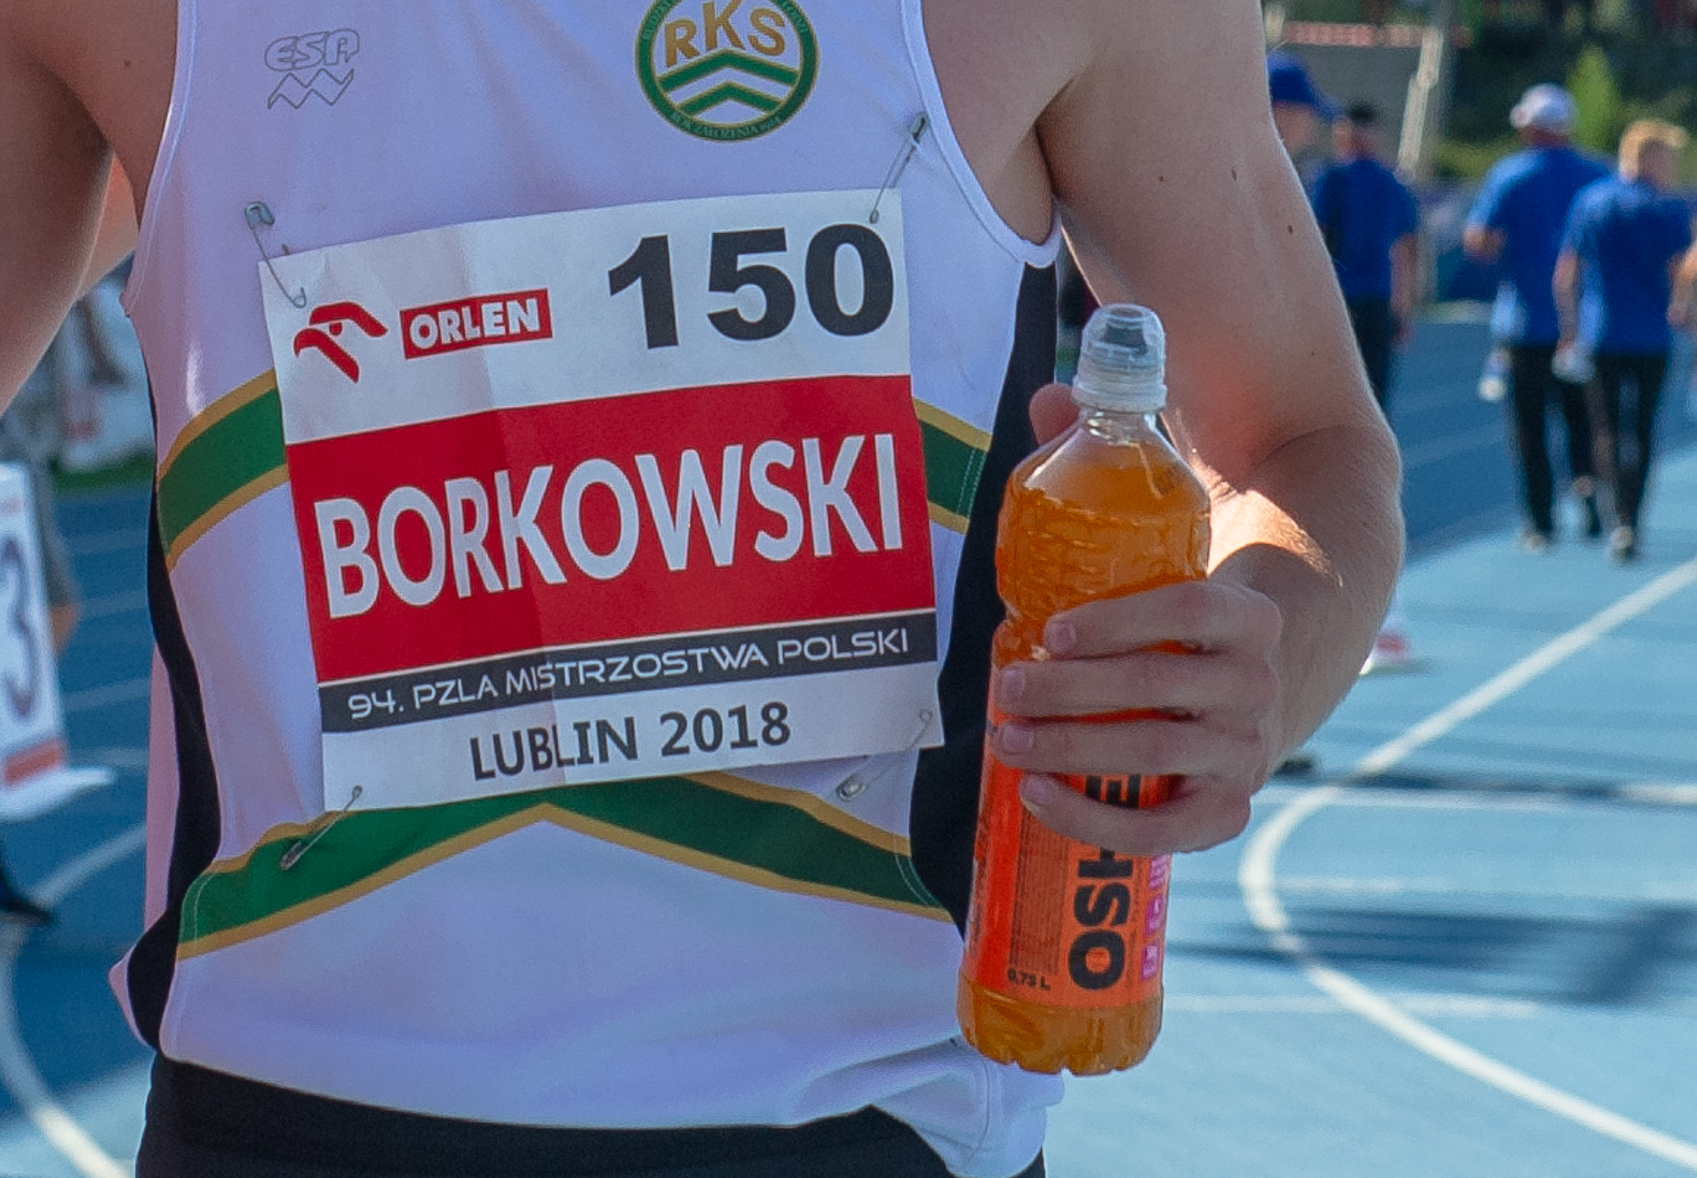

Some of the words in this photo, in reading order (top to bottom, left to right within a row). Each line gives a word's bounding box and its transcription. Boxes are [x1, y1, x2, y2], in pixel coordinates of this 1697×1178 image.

[408, 296, 541, 350] ORLEN
[607, 223, 895, 350] 150
[314, 432, 903, 619] BORKOWSKI
[348, 692, 405, 719] 94.
[413, 679, 498, 711] PZLA
[505, 645, 768, 696] MISTRZOSTWA
[777, 628, 910, 663] POLSKI
[469, 715, 638, 780] LUBLIN
[660, 701, 792, 758] 2018
